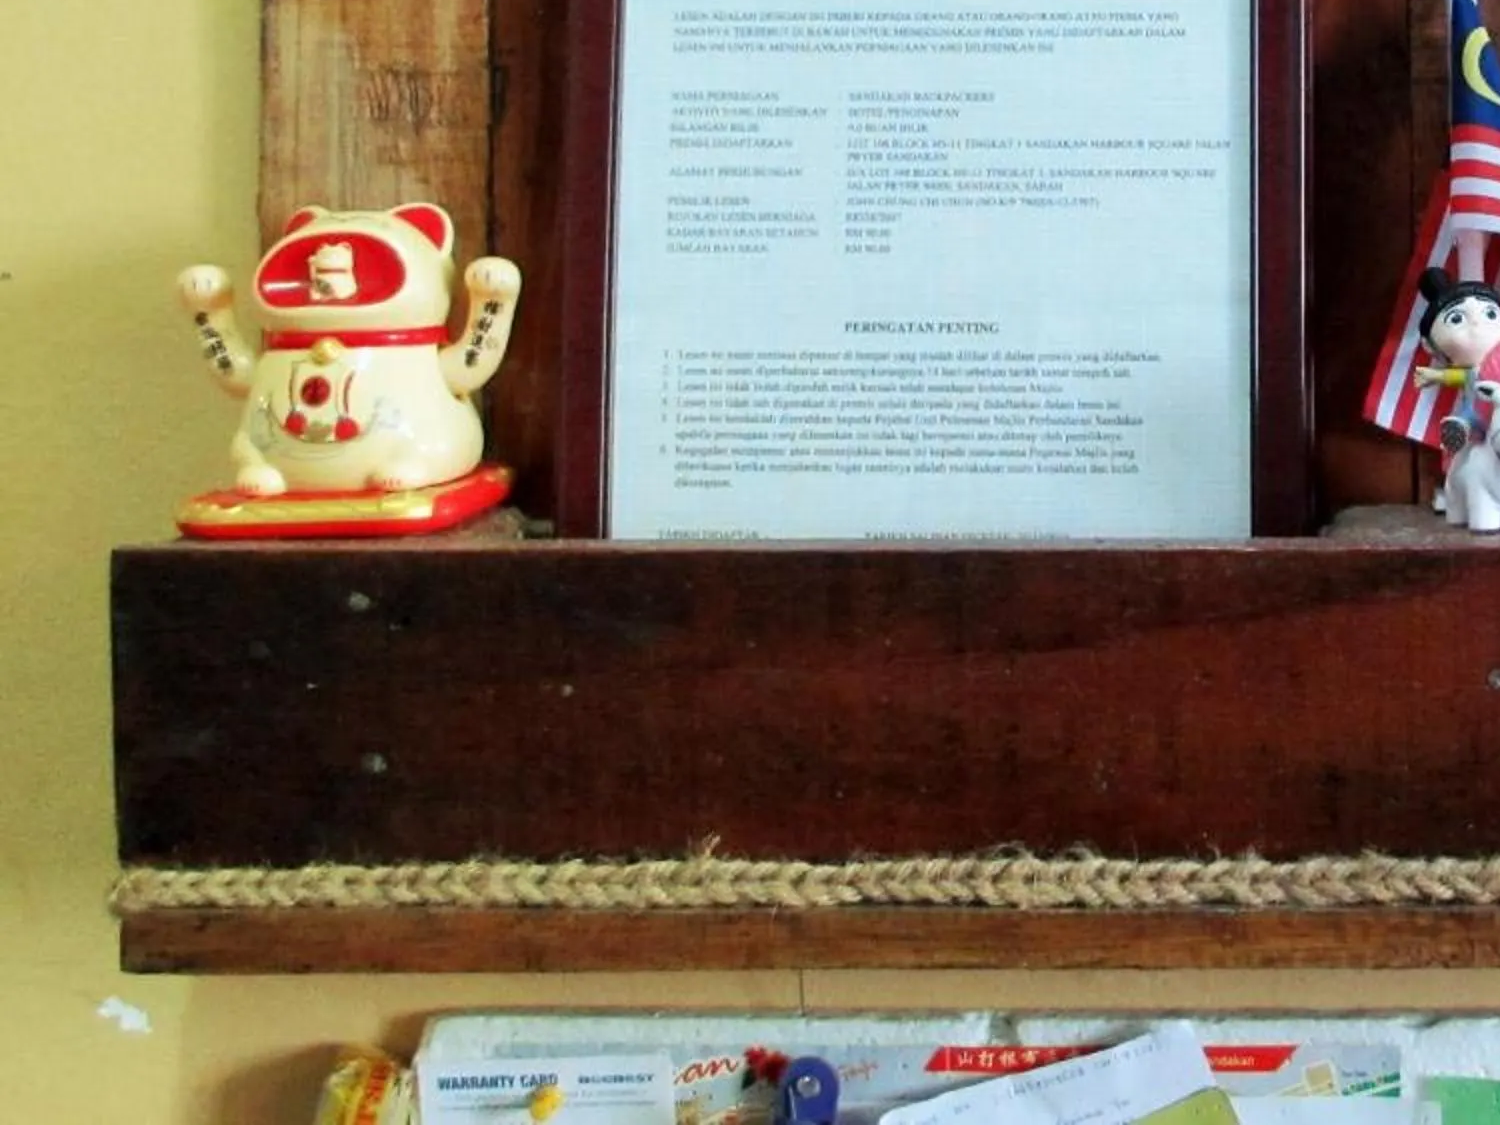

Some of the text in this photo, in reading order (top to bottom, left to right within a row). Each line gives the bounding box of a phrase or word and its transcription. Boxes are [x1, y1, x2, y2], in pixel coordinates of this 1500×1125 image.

[844, 322, 1000, 334] PERINGATAN PENTING
[437, 1075, 515, 1091] WARRANTY
